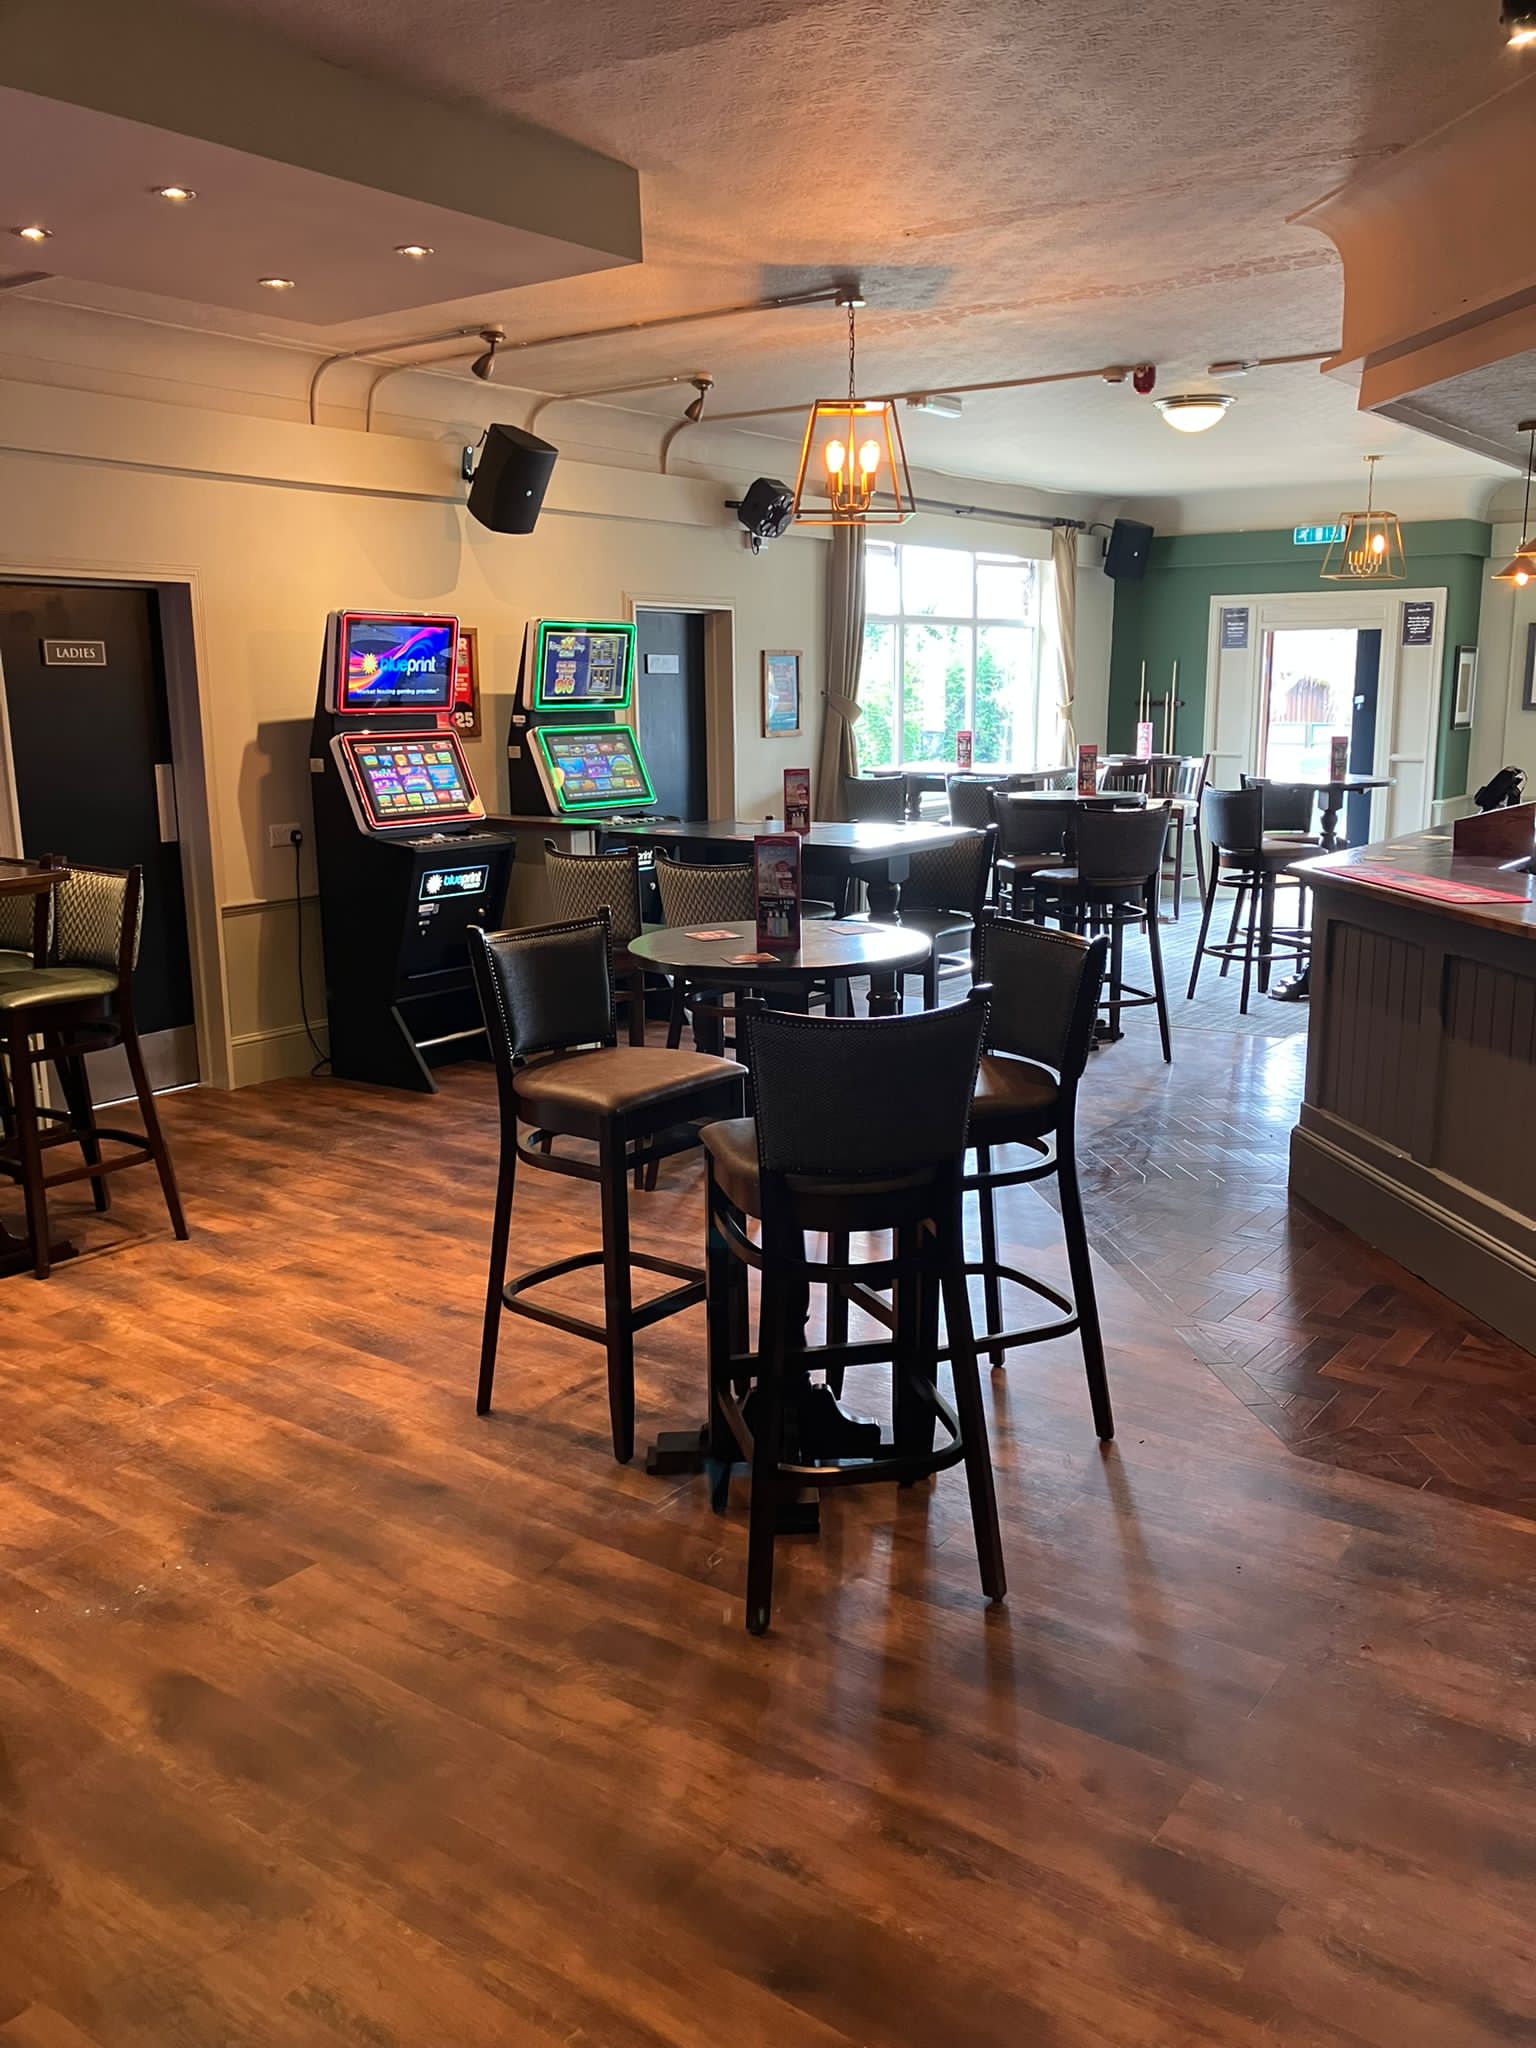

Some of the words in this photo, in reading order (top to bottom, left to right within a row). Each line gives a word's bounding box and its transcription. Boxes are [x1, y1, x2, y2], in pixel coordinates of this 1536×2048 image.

[56, 647, 96, 659] LADIES
[380, 656, 436, 676] blueprint
[455, 711, 474, 728] 25
[443, 871, 482, 887] blueprint
